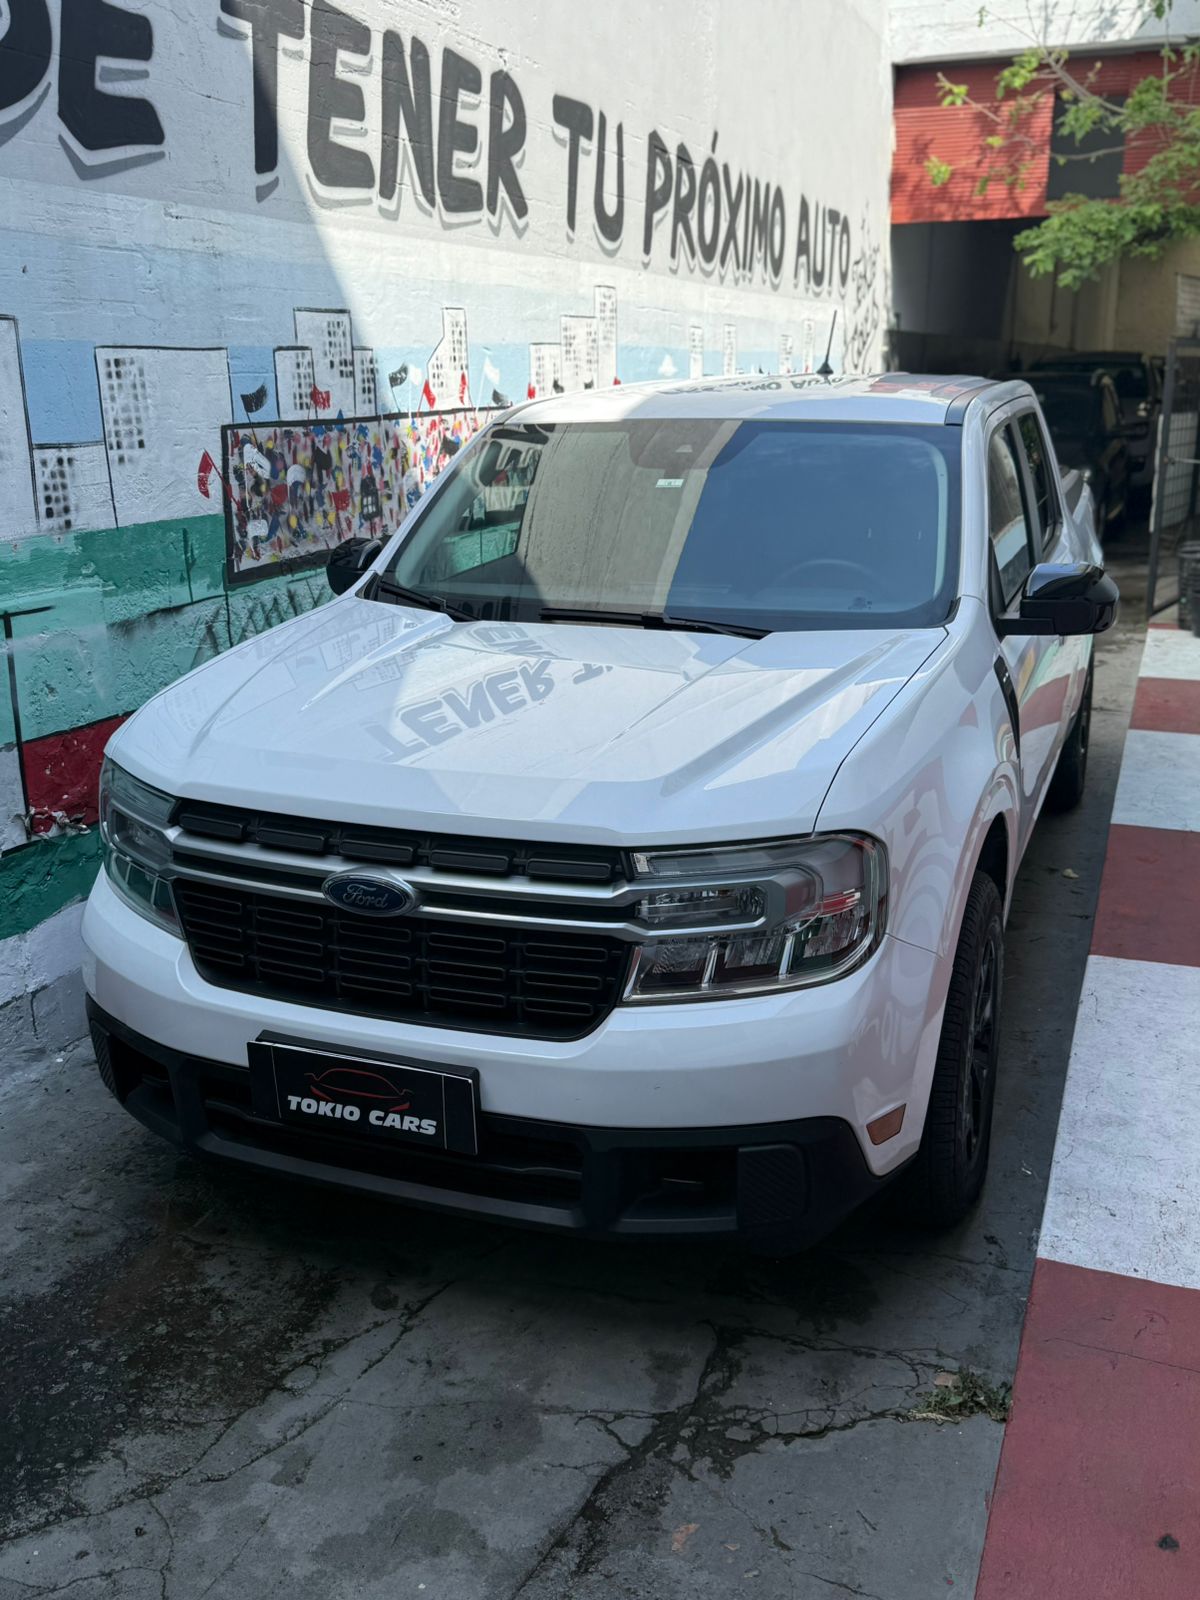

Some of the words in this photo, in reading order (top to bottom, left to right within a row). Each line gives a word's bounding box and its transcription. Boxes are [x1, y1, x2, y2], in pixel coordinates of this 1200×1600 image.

[219, 0, 529, 219] TENER
[552, 93, 625, 243] TU
[643, 130, 786, 279] PRÓXIMO
[795, 193, 850, 288] AUTO
[342, 883, 389, 908] Ford
[287, 1095, 361, 1121] TOKIO
[368, 1109, 437, 1135] CARS
